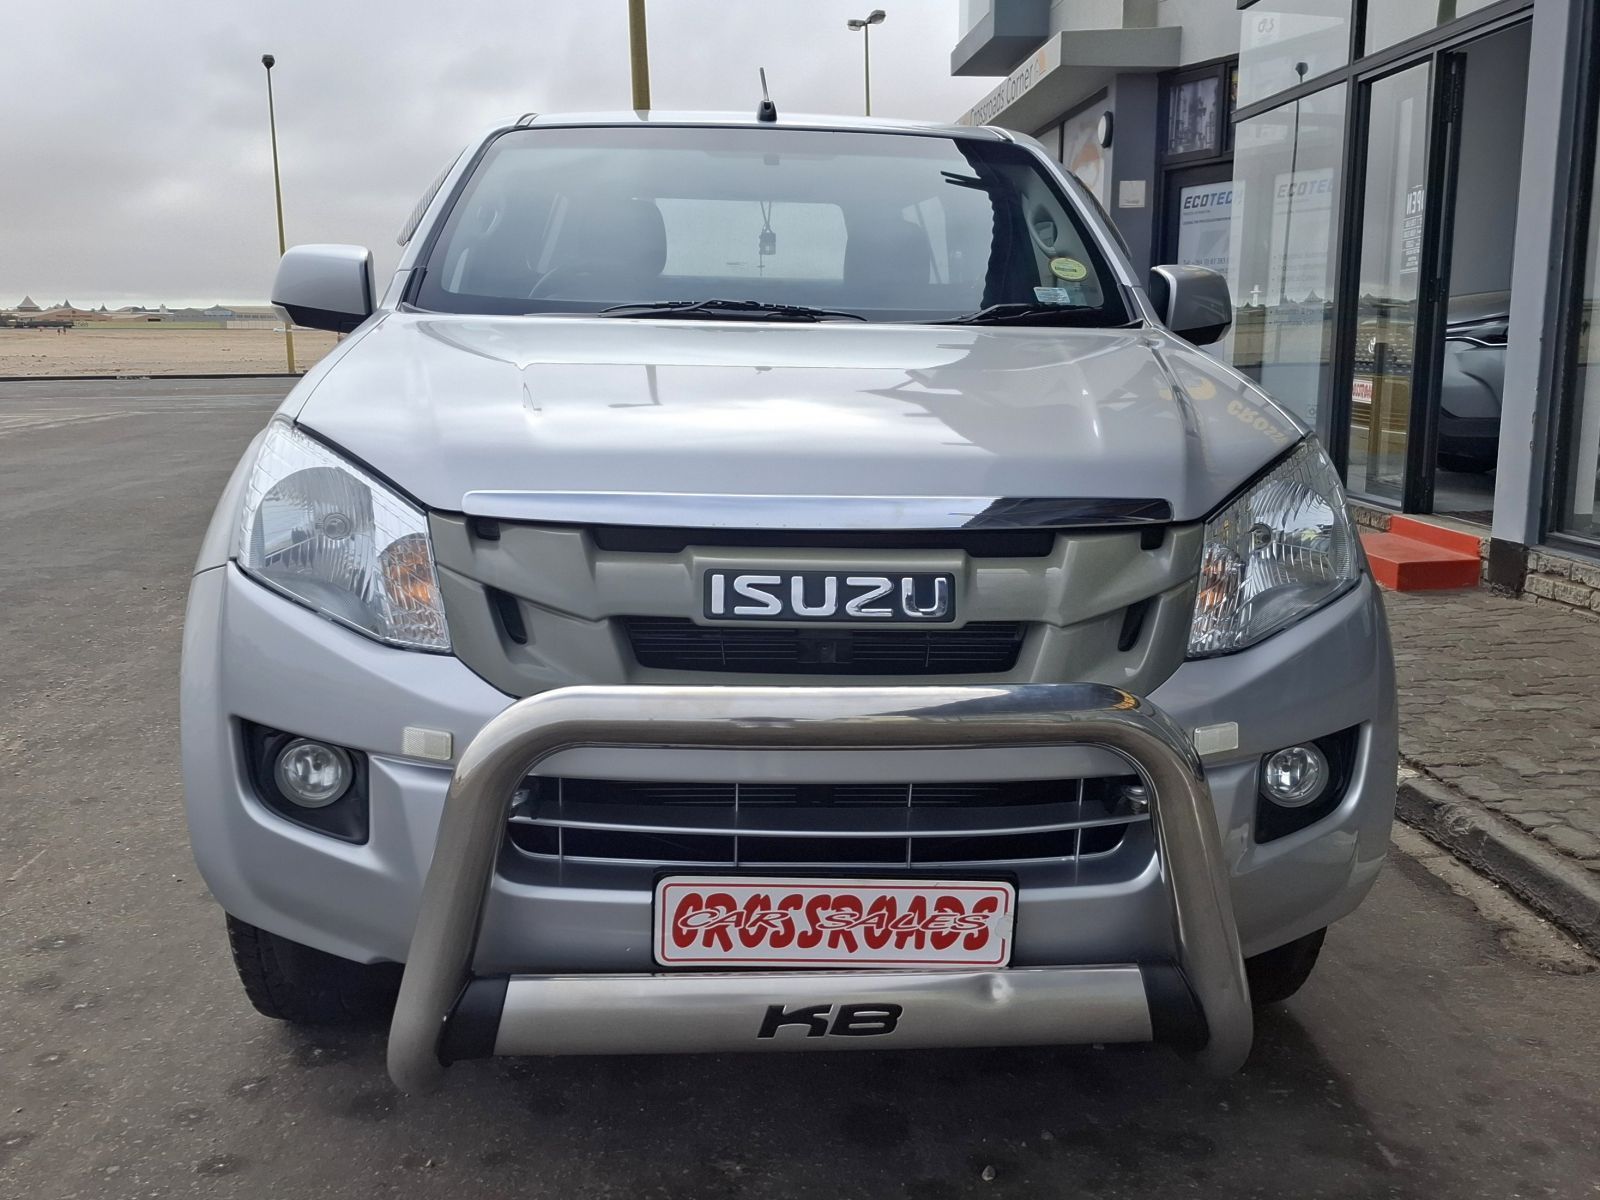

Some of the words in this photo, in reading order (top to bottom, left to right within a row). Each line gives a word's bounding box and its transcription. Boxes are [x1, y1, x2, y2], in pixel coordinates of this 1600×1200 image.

[1006, 63, 1034, 104] Corner
[711, 574, 948, 618] ISUZU
[672, 892, 999, 954] CROSSROADS
[677, 907, 792, 931] CAR
[815, 908, 990, 933] SALES
[756, 1003, 905, 1039] KB
